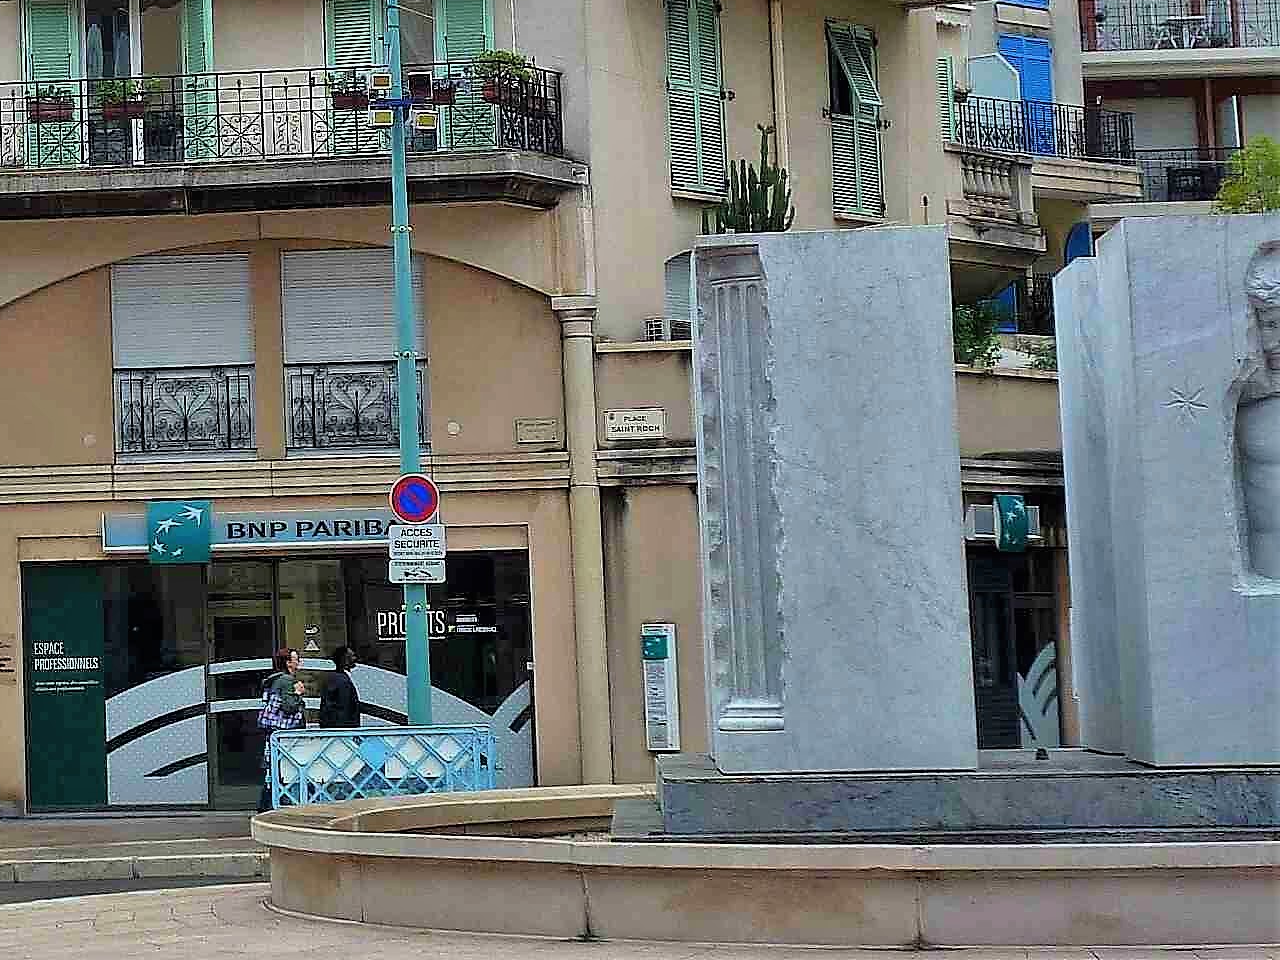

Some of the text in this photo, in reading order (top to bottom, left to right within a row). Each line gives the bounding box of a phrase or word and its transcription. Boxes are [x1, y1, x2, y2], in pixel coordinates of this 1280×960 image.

[227, 519, 397, 538] BNP PARIBA
[377, 610, 446, 635] PROTS
[33, 641, 64, 655] ESPACE
[34, 656, 99, 671] PROFESSIONNELS
